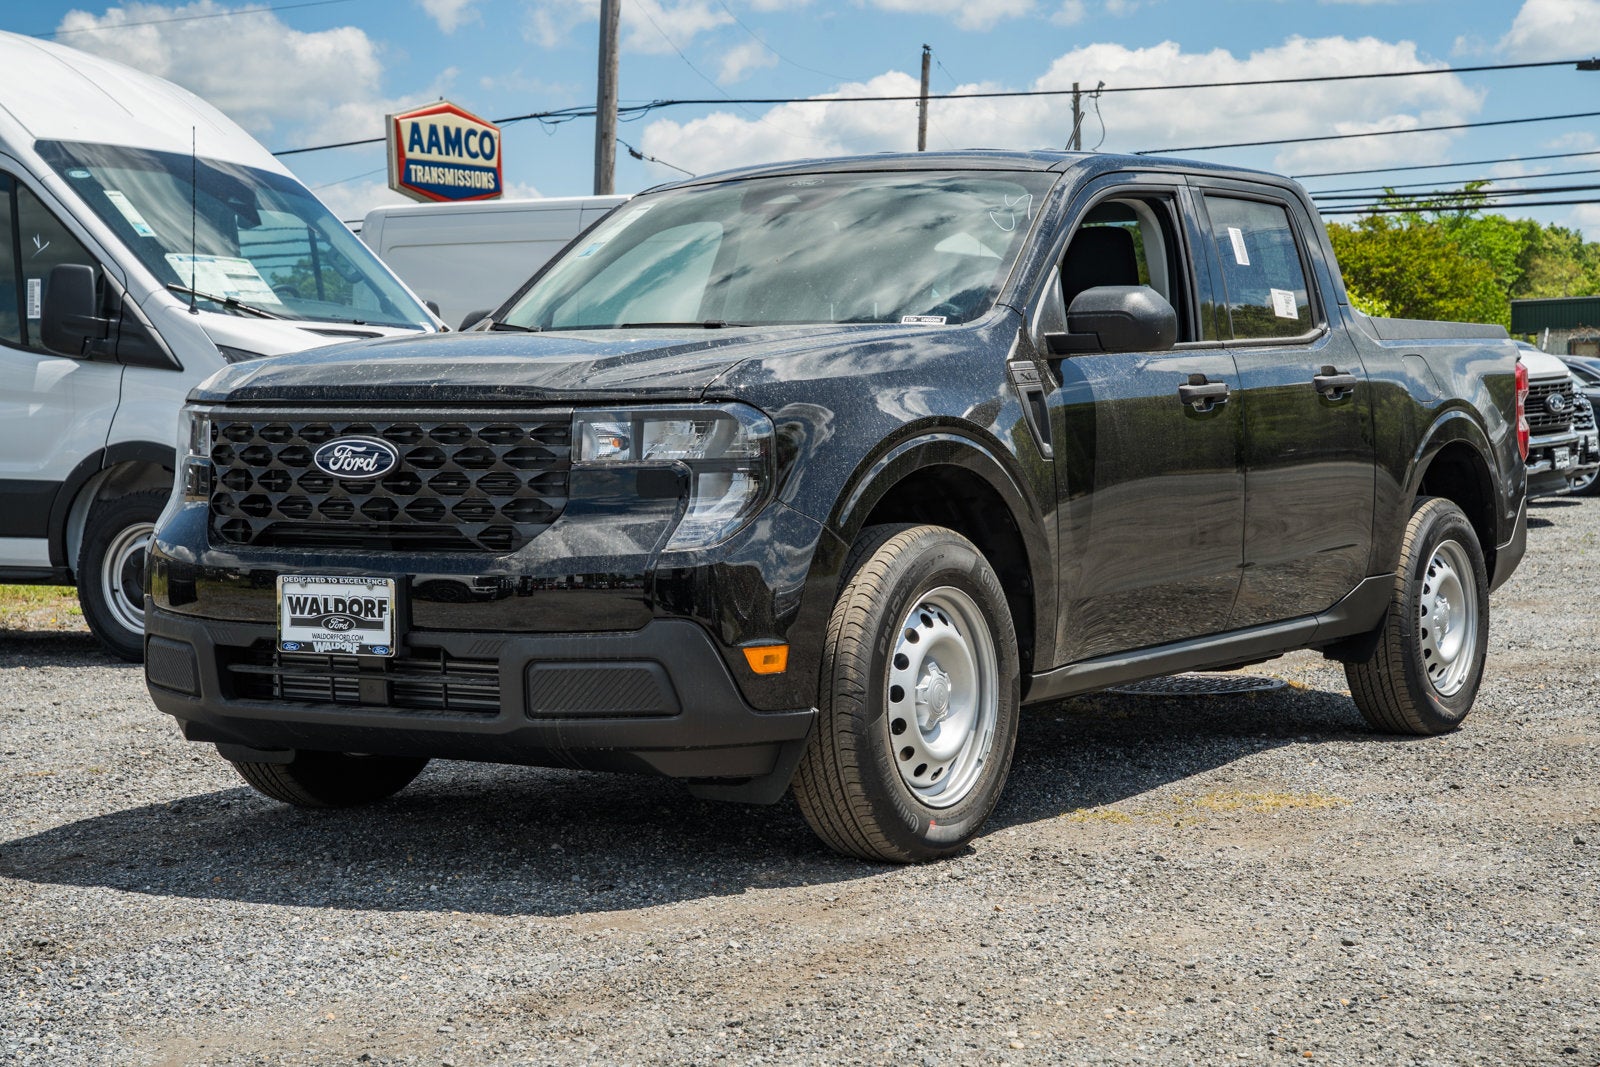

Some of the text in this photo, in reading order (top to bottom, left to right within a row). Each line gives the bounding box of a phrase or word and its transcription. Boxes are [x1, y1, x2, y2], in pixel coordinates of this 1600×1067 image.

[408, 121, 496, 161] AAMCO
[409, 164, 495, 190] TRANSMISSIONS
[1020, 372, 1037, 381] XL
[328, 444, 379, 472] Ford
[283, 576, 326, 584] DEDICATED
[339, 578, 387, 587] EXCELLENCE
[287, 595, 388, 619] WALDORF
[328, 617, 350, 630] Ford
[312, 632, 364, 641] WALDORFFORD.COM
[313, 641, 360, 655] WALDORF
